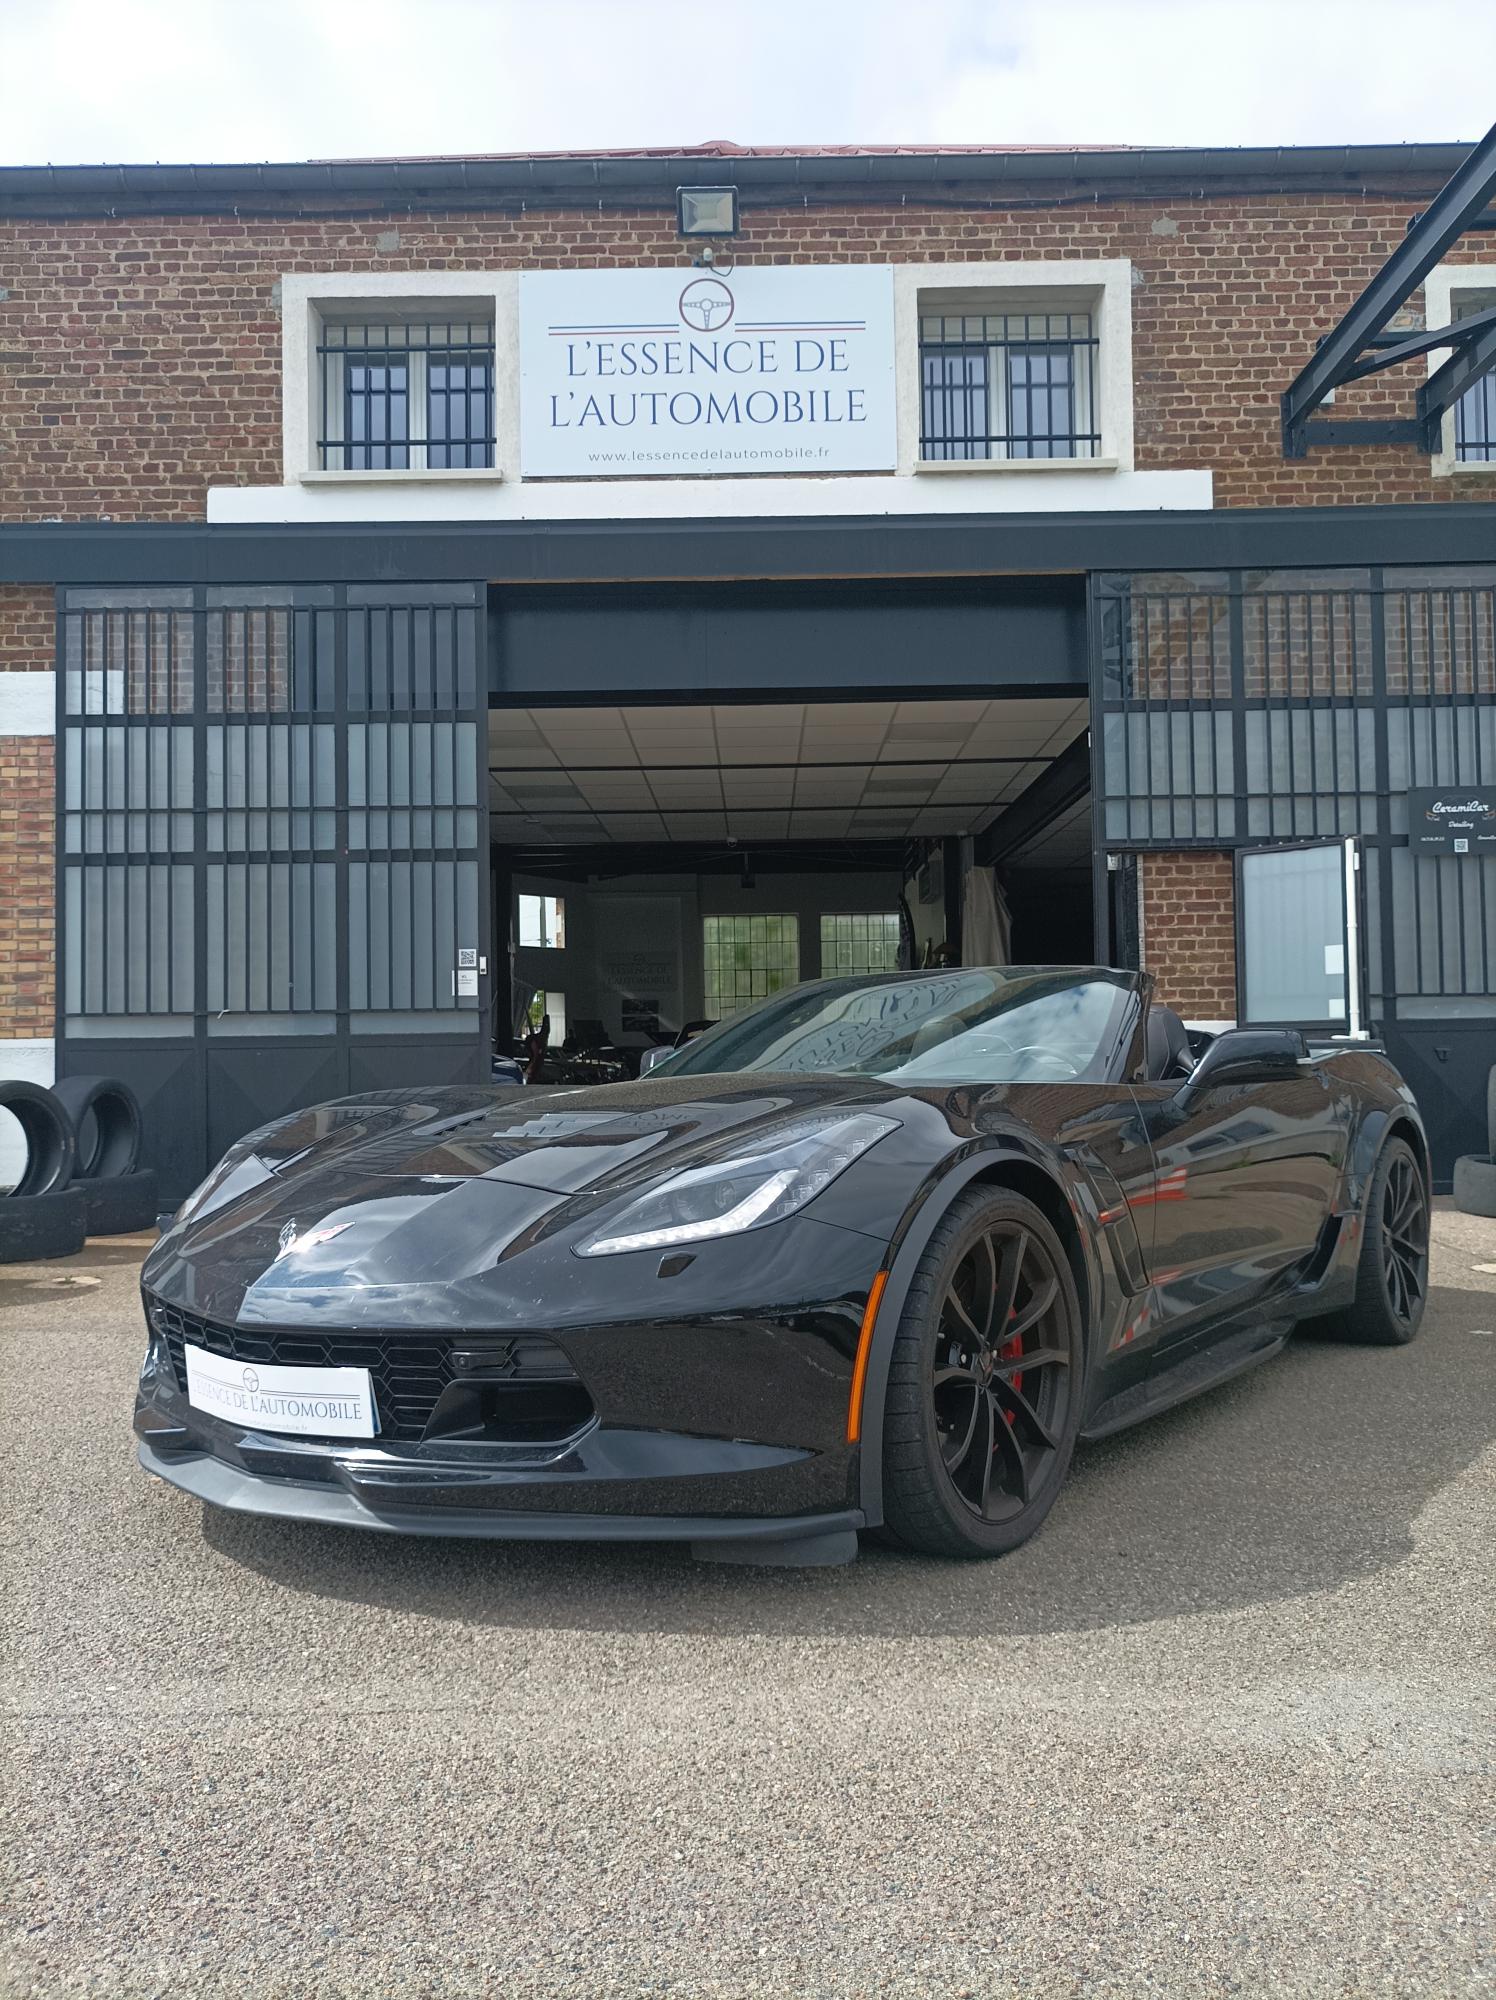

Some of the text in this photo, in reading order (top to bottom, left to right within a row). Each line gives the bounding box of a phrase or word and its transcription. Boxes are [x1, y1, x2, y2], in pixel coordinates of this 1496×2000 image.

[567, 339, 850, 376] L'ESSENCE DE
[550, 389, 868, 427] L'AUTOMOBILE
[588, 447, 830, 462] www.lessencedelautomobile.fr
[1432, 800, 1489, 813] CeramiCar
[233, 1392, 249, 1410] DE
[250, 1395, 363, 1420] L'AUTOMOBILE
